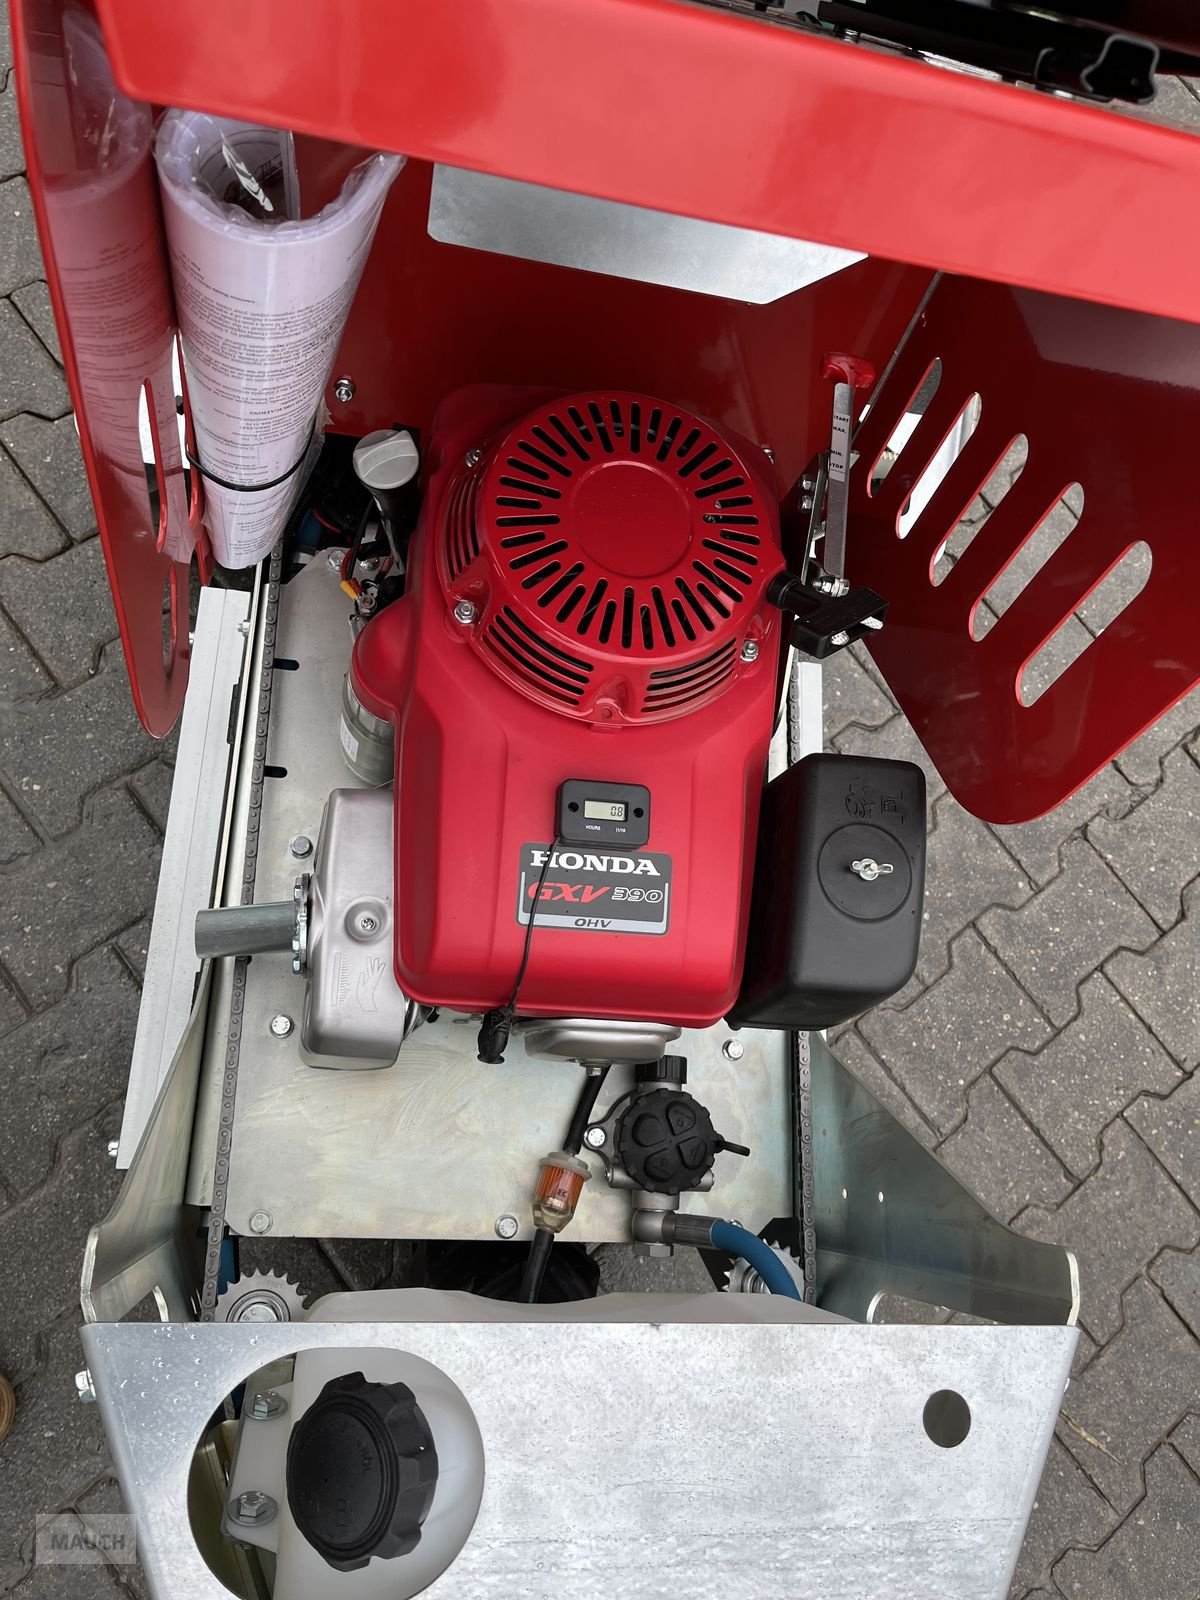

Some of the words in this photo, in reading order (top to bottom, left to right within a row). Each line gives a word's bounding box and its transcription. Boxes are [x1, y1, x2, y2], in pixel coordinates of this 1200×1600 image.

[530, 850, 661, 876] HONDA
[527, 881, 611, 903] GXV
[611, 886, 663, 903] 390
[574, 918, 612, 928] OHV
